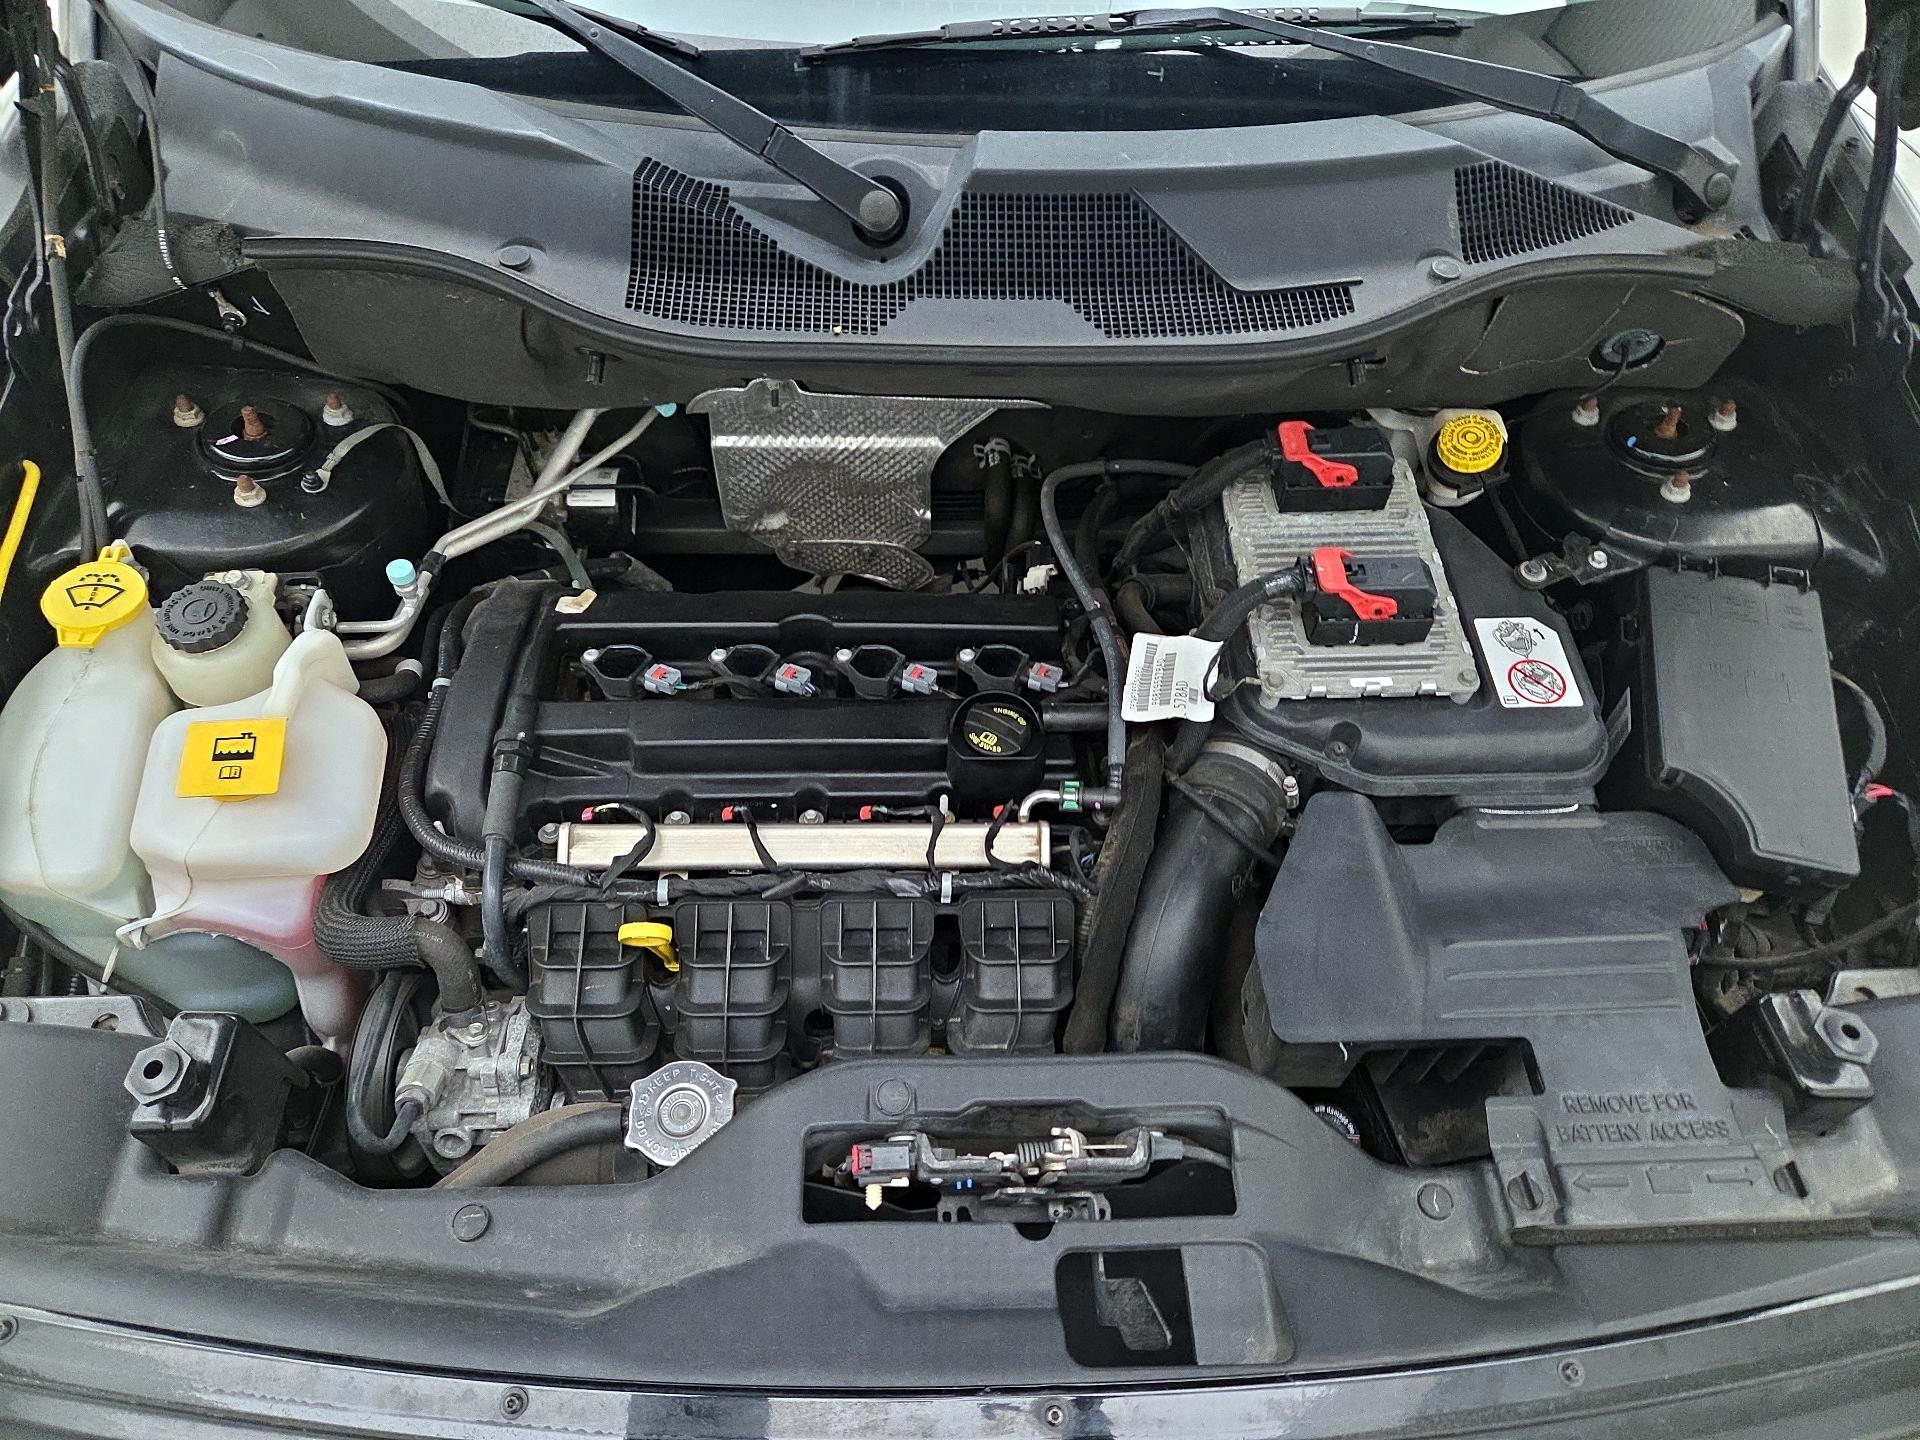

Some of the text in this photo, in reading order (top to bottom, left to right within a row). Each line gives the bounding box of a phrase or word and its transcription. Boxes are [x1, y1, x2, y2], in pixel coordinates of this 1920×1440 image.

[648, 1068, 681, 1094] KEEP
[1561, 1091, 1699, 1114] REMOVE FOR
[1556, 1119, 1730, 1143] BATTERY ACCESS
